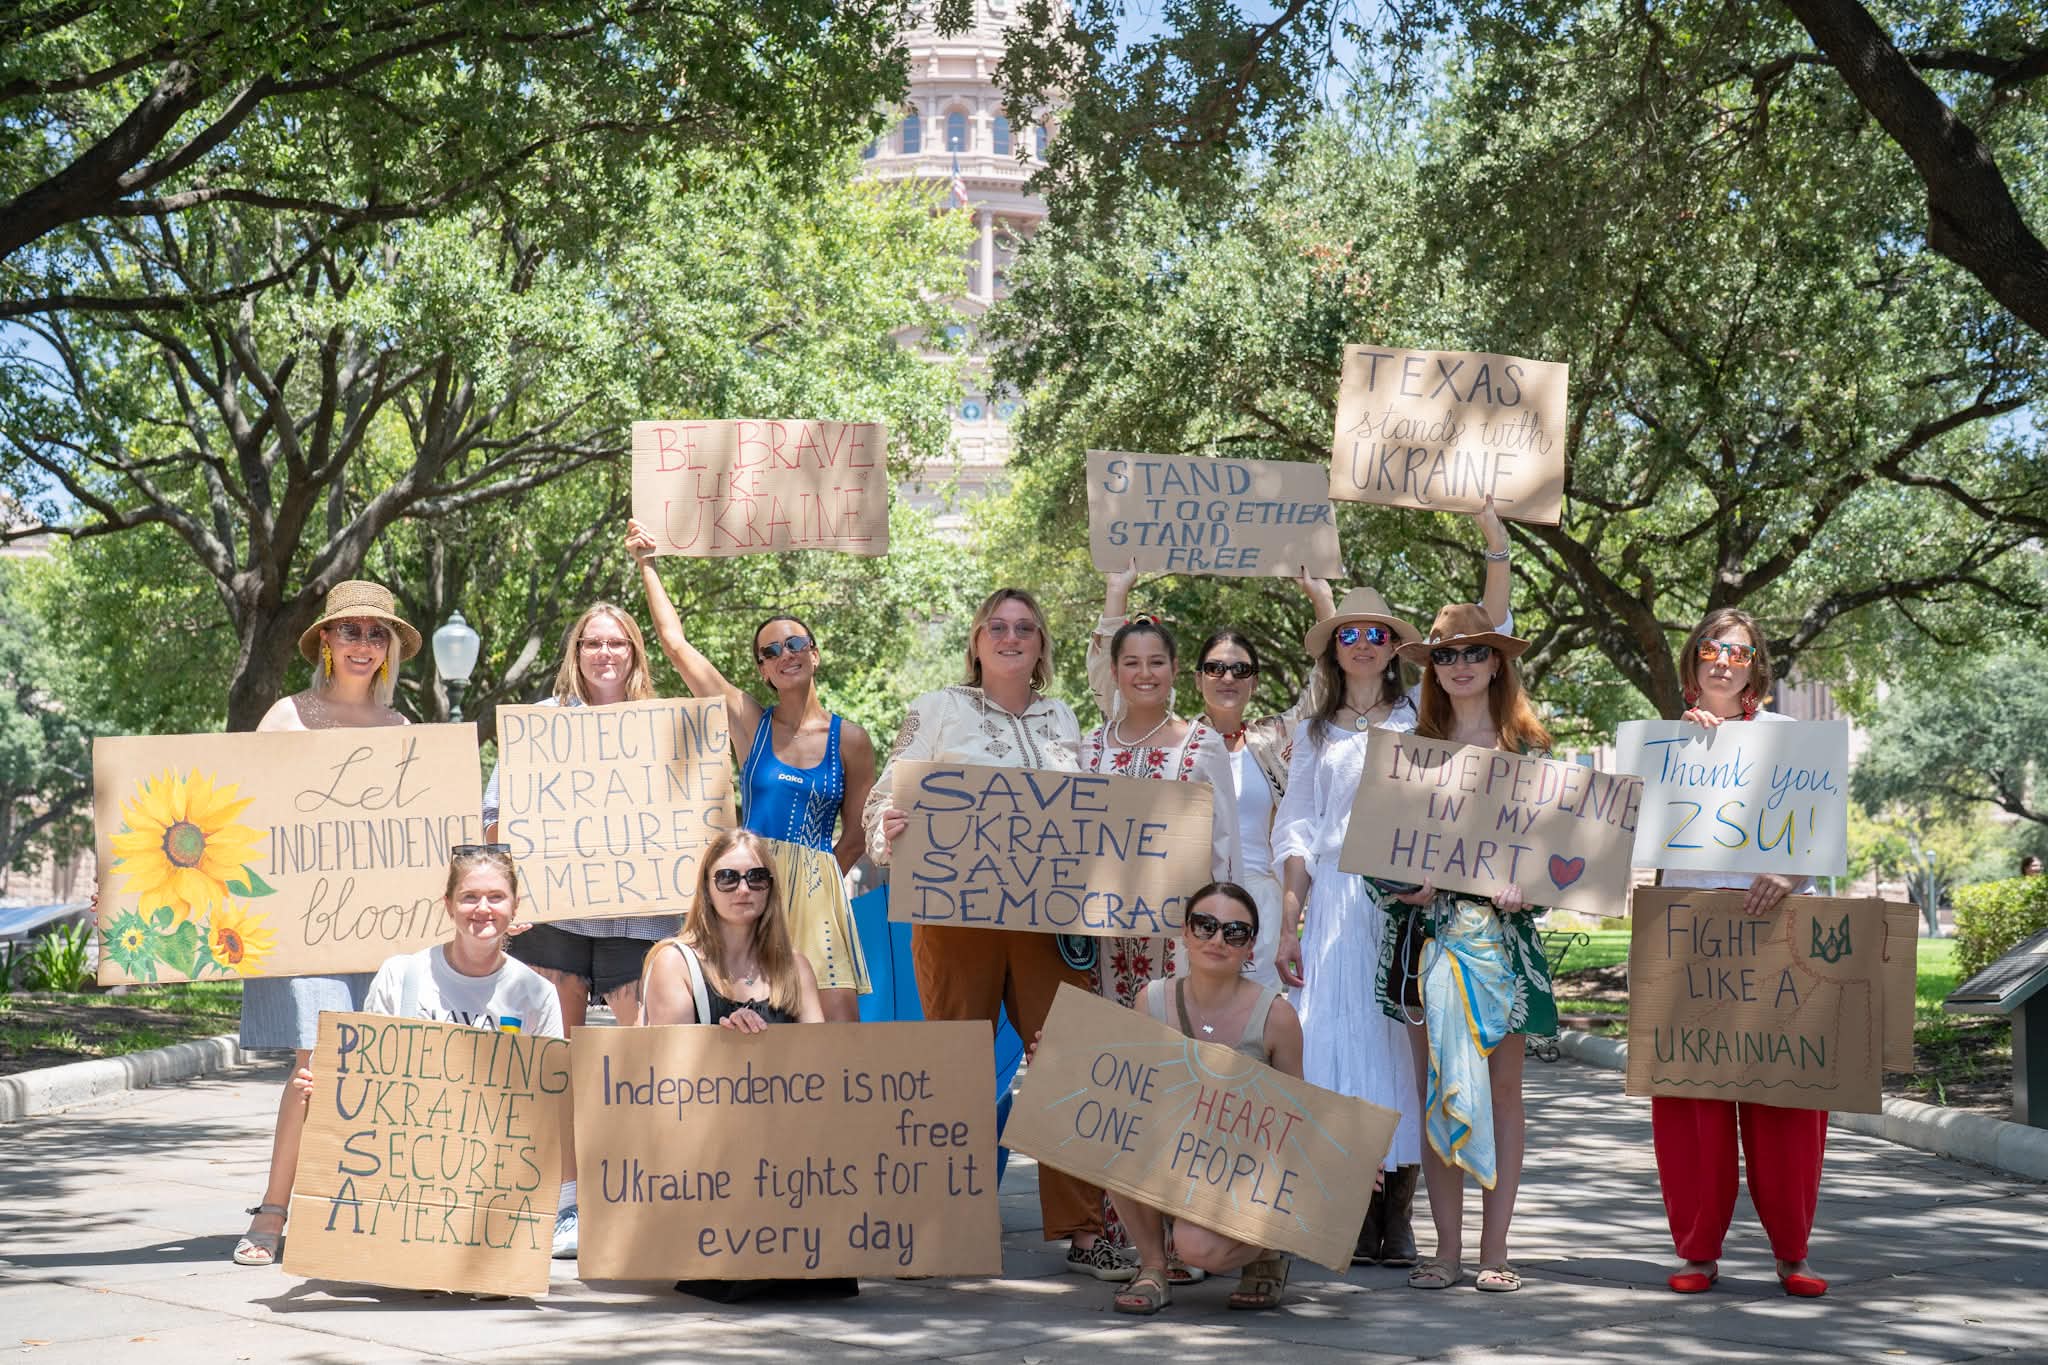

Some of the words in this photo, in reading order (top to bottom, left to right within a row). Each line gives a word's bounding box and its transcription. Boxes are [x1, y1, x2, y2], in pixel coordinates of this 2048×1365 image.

[1357, 351, 1524, 407] TEXAS
[652, 426, 707, 471] BE
[734, 422, 875, 469] BRAVE
[1348, 403, 1465, 446] stands
[1480, 410, 1552, 455] with
[697, 470, 768, 499] LIKE
[1103, 460, 1250, 496] STAND
[1352, 442, 1517, 504] UKRAINE
[665, 487, 872, 549] UKRAINE
[1107, 521, 1230, 547] STAND
[1147, 499, 1334, 525] TOGETHER
[1166, 547, 1260, 569] FREE
[503, 703, 728, 765] PROTECTING
[294, 737, 431, 812] Let
[509, 761, 725, 815] UKRAINE
[913, 770, 1109, 813] SAVE
[1389, 744, 1644, 832] INDEPEDENCE
[1644, 738, 1755, 788] Thank
[1768, 764, 1838, 810] you,
[926, 813, 1167, 861] UKRAINE
[1427, 792, 1465, 822] IN
[1496, 804, 1541, 835] MY
[269, 814, 478, 875] INDEPENDENCE
[912, 851, 1086, 890] SAVE
[1390, 828, 1532, 883] HEART
[299, 877, 455, 945] bloom
[515, 855, 695, 913] AMERIC
[912, 886, 1192, 932] DEMOCRAC
[1667, 904, 1770, 959] FIGHT
[1686, 963, 1757, 1001] LIKE
[1775, 968, 1799, 1008] A
[337, 1023, 569, 1094] PROTECTING
[1654, 1026, 1825, 1070] UKRAINIAN
[336, 1076, 534, 1140] UKRAINE
[603, 1055, 824, 1121] Independence
[843, 1068, 872, 1103] is
[882, 1070, 933, 1101] not
[1091, 1052, 1160, 1104] ONE
[1192, 1084, 1304, 1154] HEART
[896, 1108, 969, 1147] free
[338, 1130, 541, 1192] SECURES
[601, 1158, 731, 1203] Ukraine
[754, 1157, 857, 1208] fights
[874, 1152, 927, 1195] for
[947, 1153, 983, 1196] it
[1075, 1100, 1143, 1152] ONE
[1171, 1132, 1298, 1215] PEOPLE
[325, 1177, 540, 1249] AMERICA
[699, 1224, 821, 1269] every
[848, 1212, 913, 1265] day
